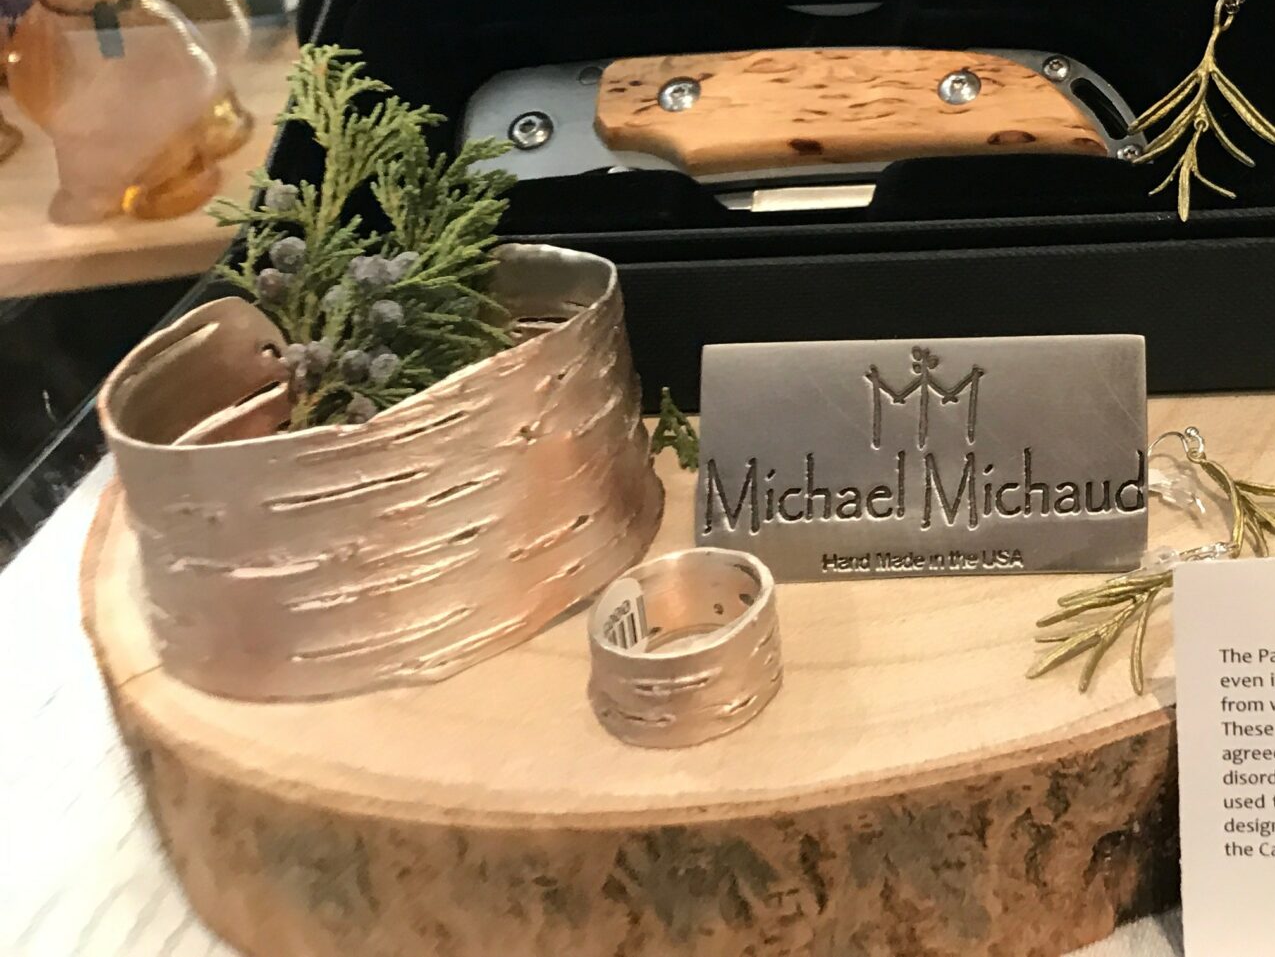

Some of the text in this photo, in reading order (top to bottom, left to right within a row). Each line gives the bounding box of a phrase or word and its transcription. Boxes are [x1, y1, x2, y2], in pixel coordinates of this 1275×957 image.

[702, 446, 1147, 535] Michael Michaud
[821, 548, 1024, 573] Hand Made in the USA
[1219, 648, 1252, 663] The
[1221, 696, 1264, 712] from
[1224, 842, 1253, 857] the
